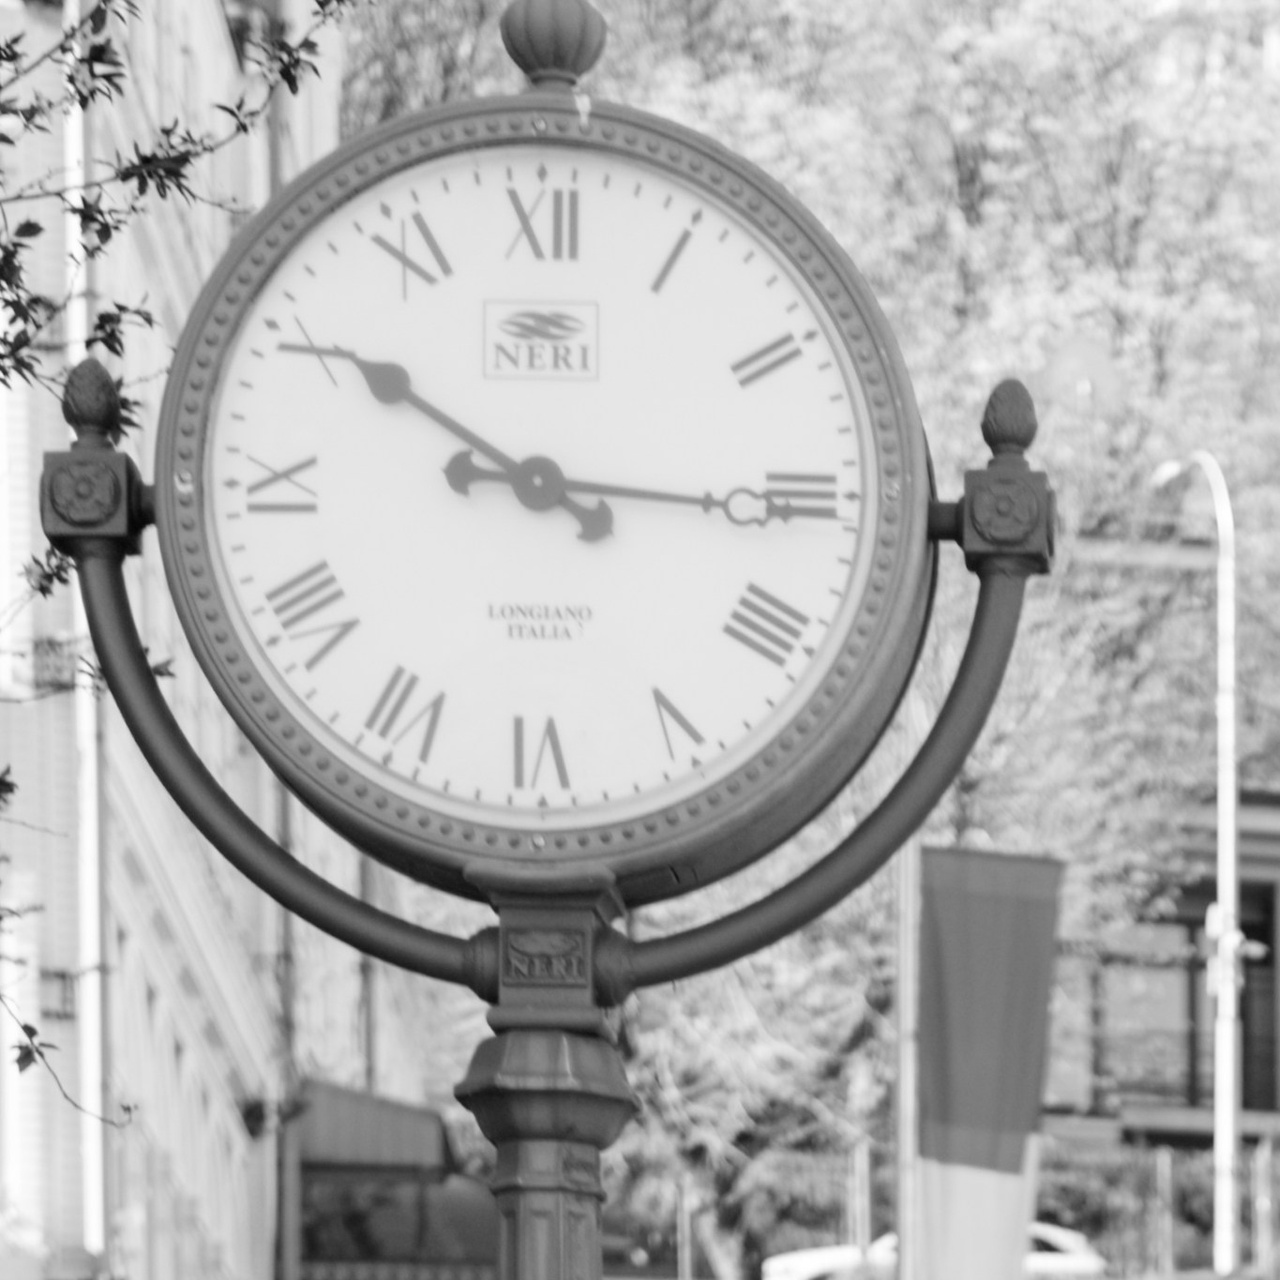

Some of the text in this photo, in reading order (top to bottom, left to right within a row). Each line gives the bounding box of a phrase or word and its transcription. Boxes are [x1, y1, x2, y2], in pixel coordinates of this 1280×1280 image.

[371, 209, 453, 301] XI
[506, 187, 578, 262] XII
[493, 342, 592, 372] NERI
[730, 332, 803, 388] II
[246, 454, 319, 514] IX
[765, 472, 838, 519] III
[265, 558, 361, 673] VIII
[487, 602, 593, 621] LONGIANO
[507, 622, 573, 641] ITALIA
[722, 582, 811, 668] IIII
[364, 664, 446, 765] VII
[513, 715, 571, 791] VI
